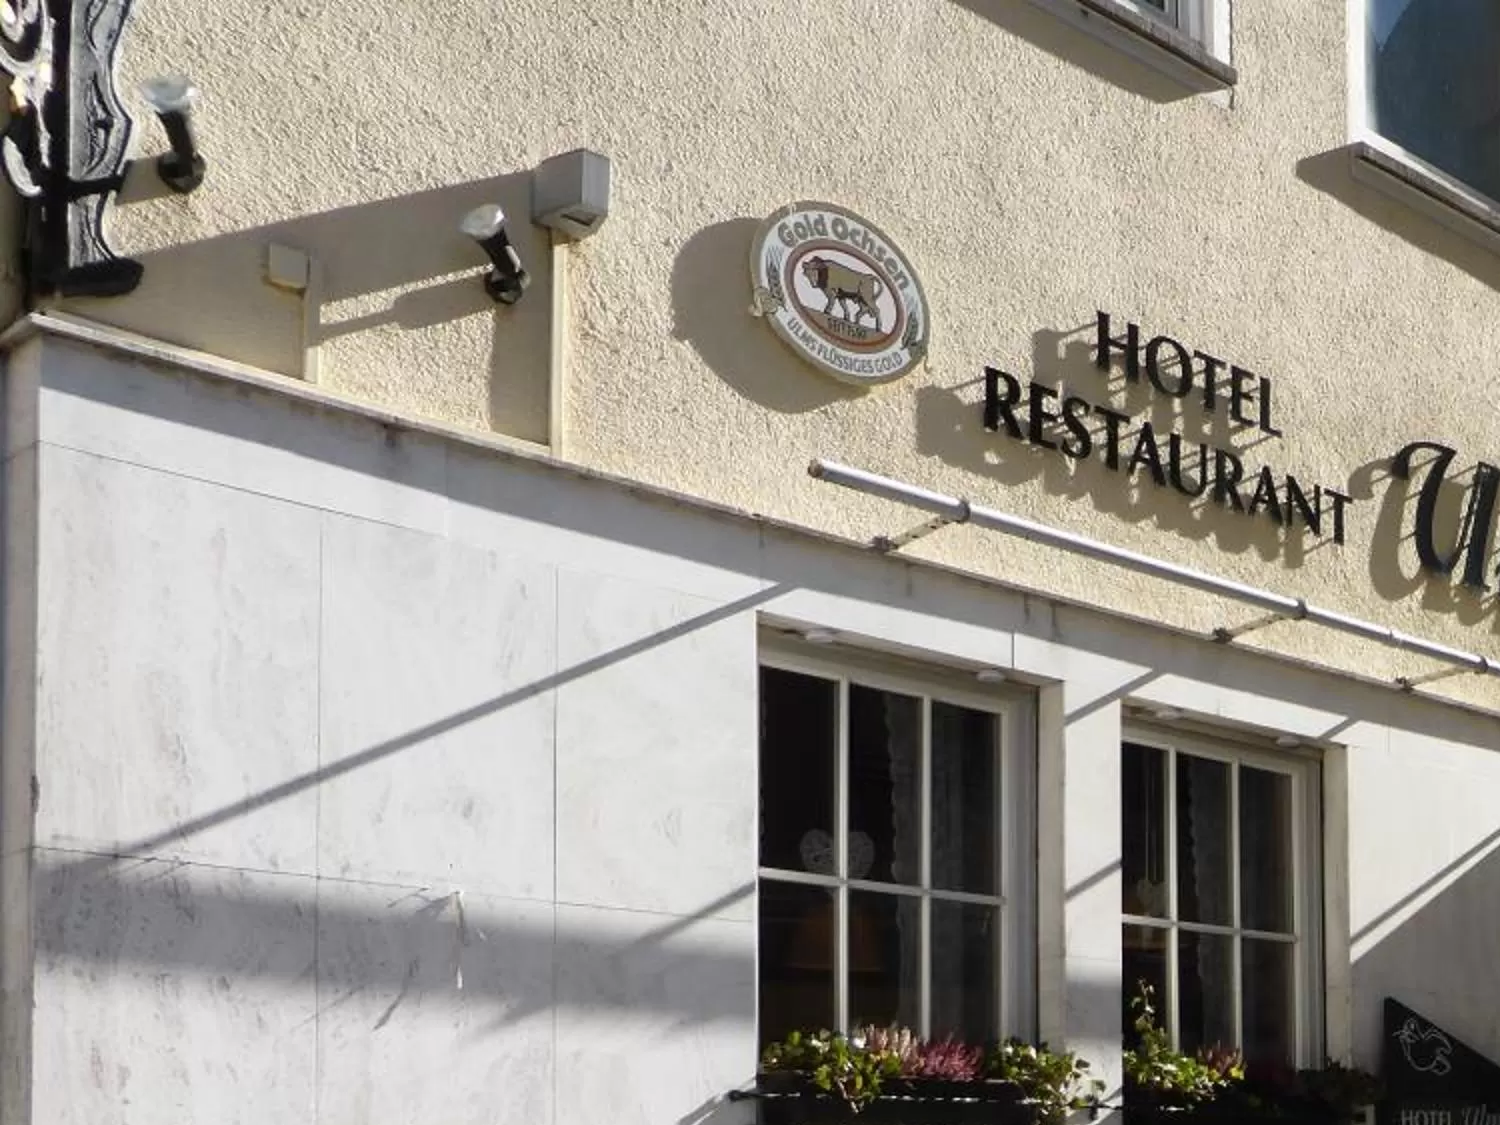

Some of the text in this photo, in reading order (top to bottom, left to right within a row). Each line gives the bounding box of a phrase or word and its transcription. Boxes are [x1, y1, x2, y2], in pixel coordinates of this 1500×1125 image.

[778, 214, 910, 291] Gold Ochsen
[875, 351, 903, 373] GOLD
[1096, 310, 1283, 438] HOTEL
[983, 365, 1353, 545] RESTAURANT
